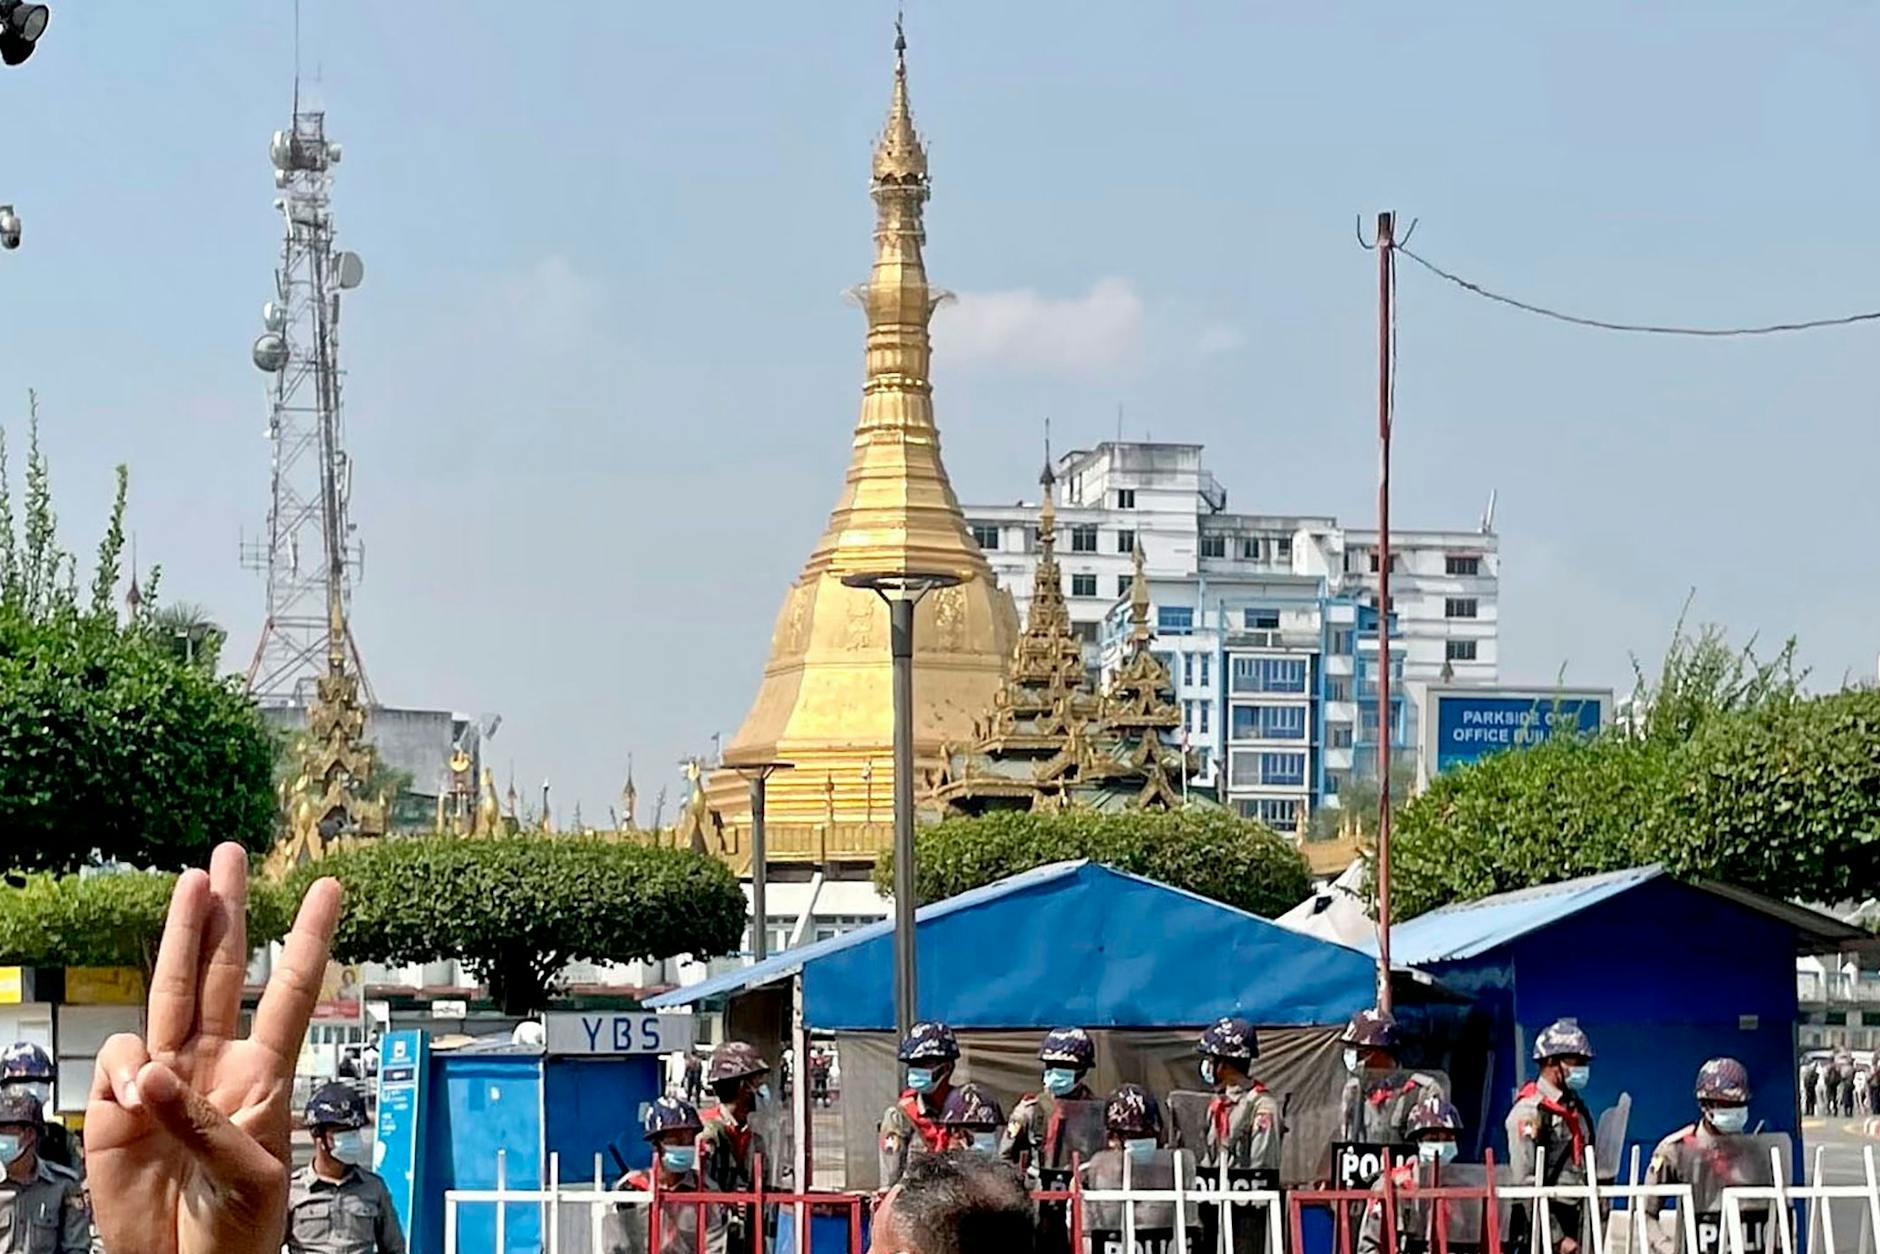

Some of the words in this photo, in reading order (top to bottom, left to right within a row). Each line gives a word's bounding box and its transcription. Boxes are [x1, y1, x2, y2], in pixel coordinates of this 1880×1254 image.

[1463, 710, 1541, 726] PARKSIDE
[1453, 728, 1508, 743] OFFICE
[582, 1017, 660, 1051] YBS
